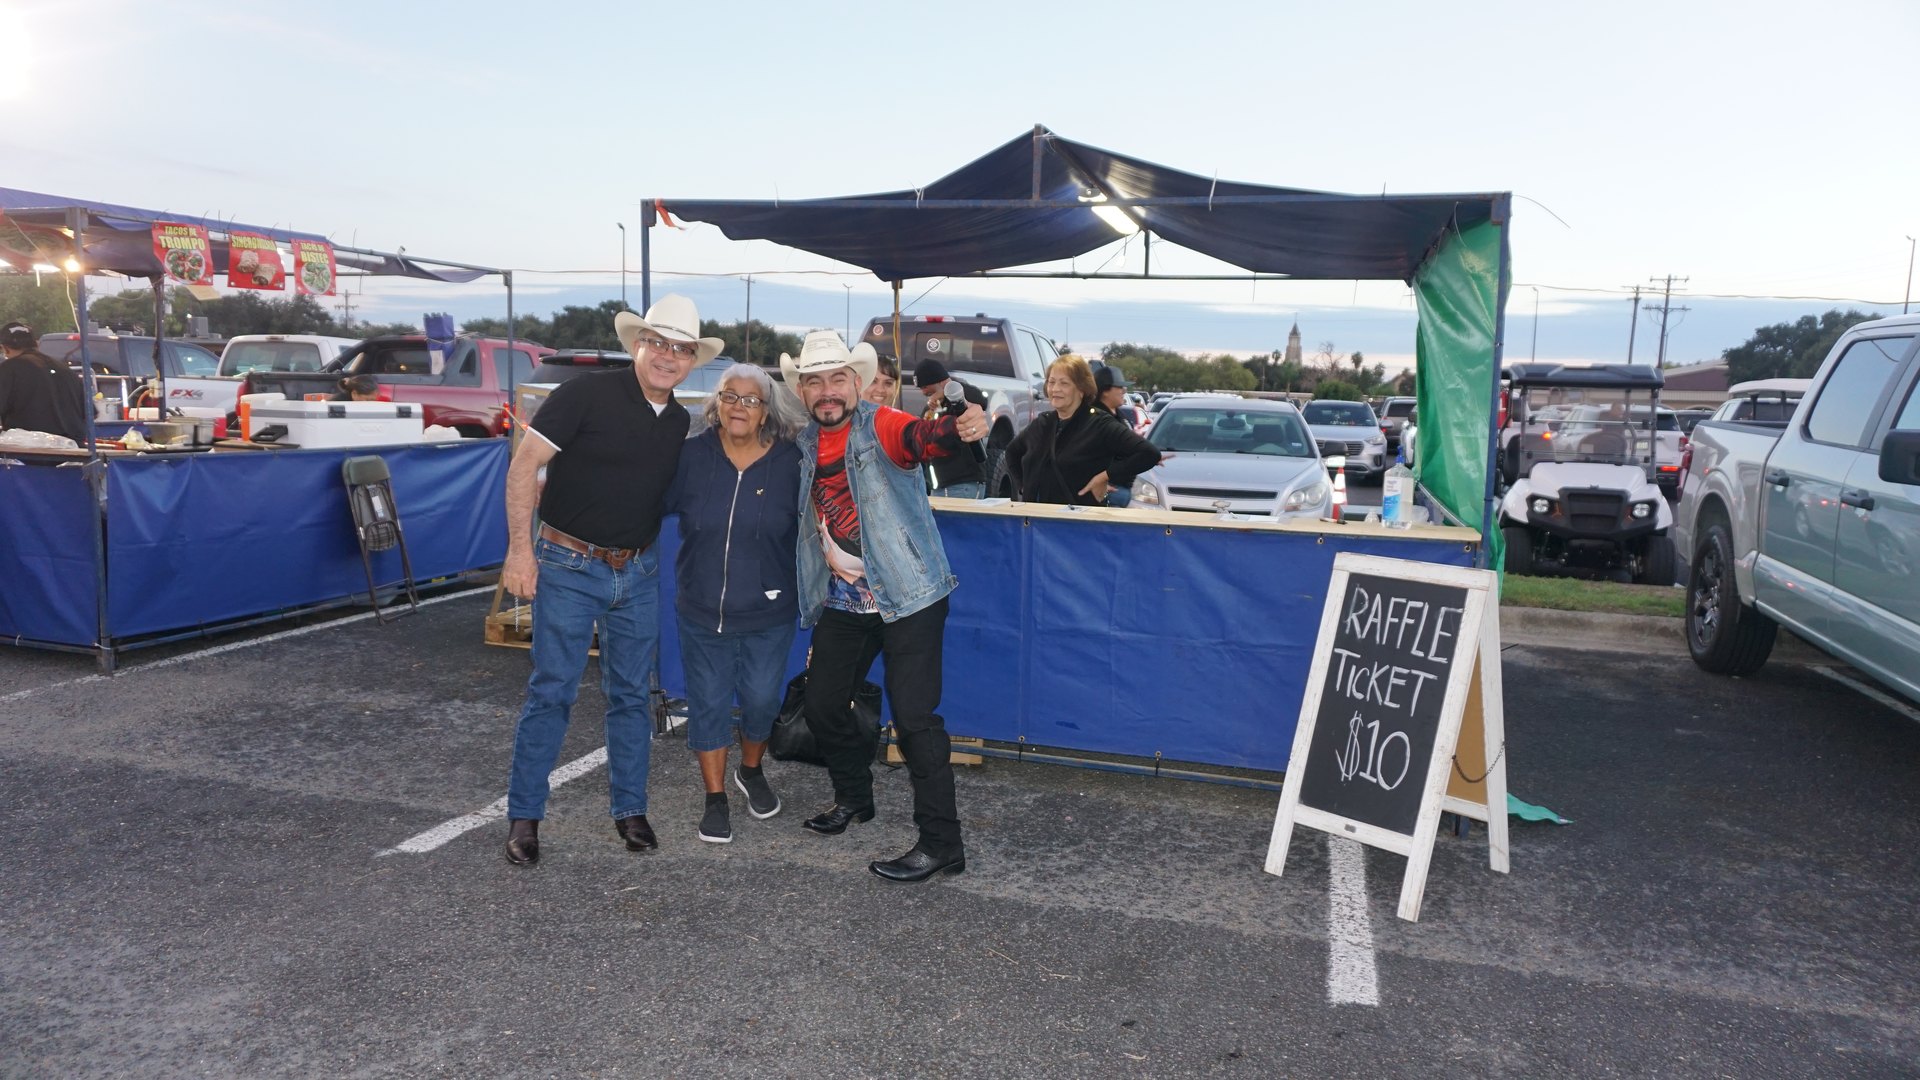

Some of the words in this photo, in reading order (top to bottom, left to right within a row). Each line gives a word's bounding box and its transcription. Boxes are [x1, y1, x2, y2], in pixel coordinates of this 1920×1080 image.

[164, 225, 188, 235] TACOS
[188, 227, 197, 236] DE
[158, 235, 206, 251] TROMPO
[300, 242, 317, 251] TACOS
[300, 251, 329, 263] BISTEC
[169, 389, 204, 397] FX4
[1344, 584, 1463, 663] RAFFLE
[1334, 648, 1438, 717] TICKET
[1335, 711, 1411, 790] $10
